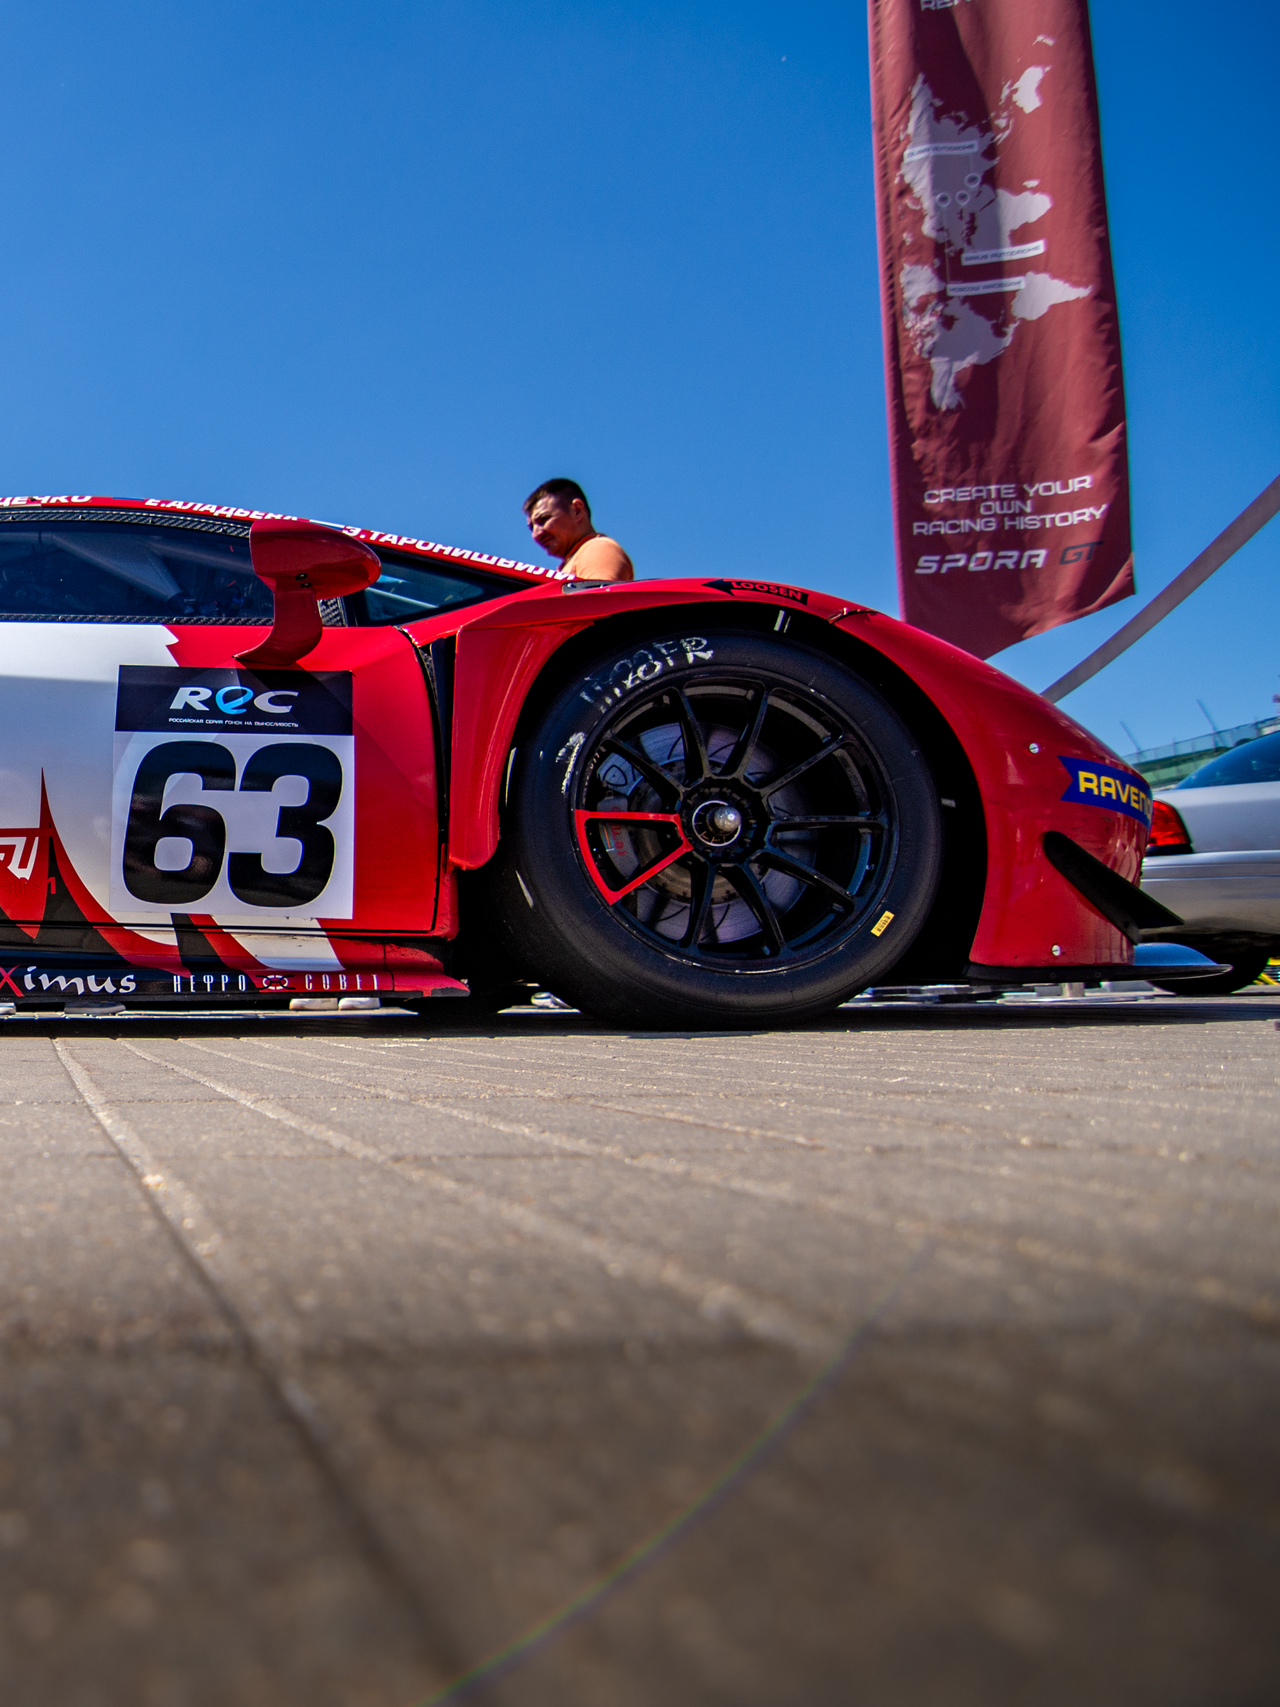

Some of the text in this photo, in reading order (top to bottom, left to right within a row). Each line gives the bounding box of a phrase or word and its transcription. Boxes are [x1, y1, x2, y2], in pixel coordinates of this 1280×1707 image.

[923, 475, 1093, 504] CREATE YOUR
[912, 504, 1108, 536] RACING HISTORY
[980, 500, 1032, 516] OWN
[914, 541, 1104, 575] SPORA GT
[730, 581, 802, 601] LOOSEN
[122, 740, 344, 908] 63
